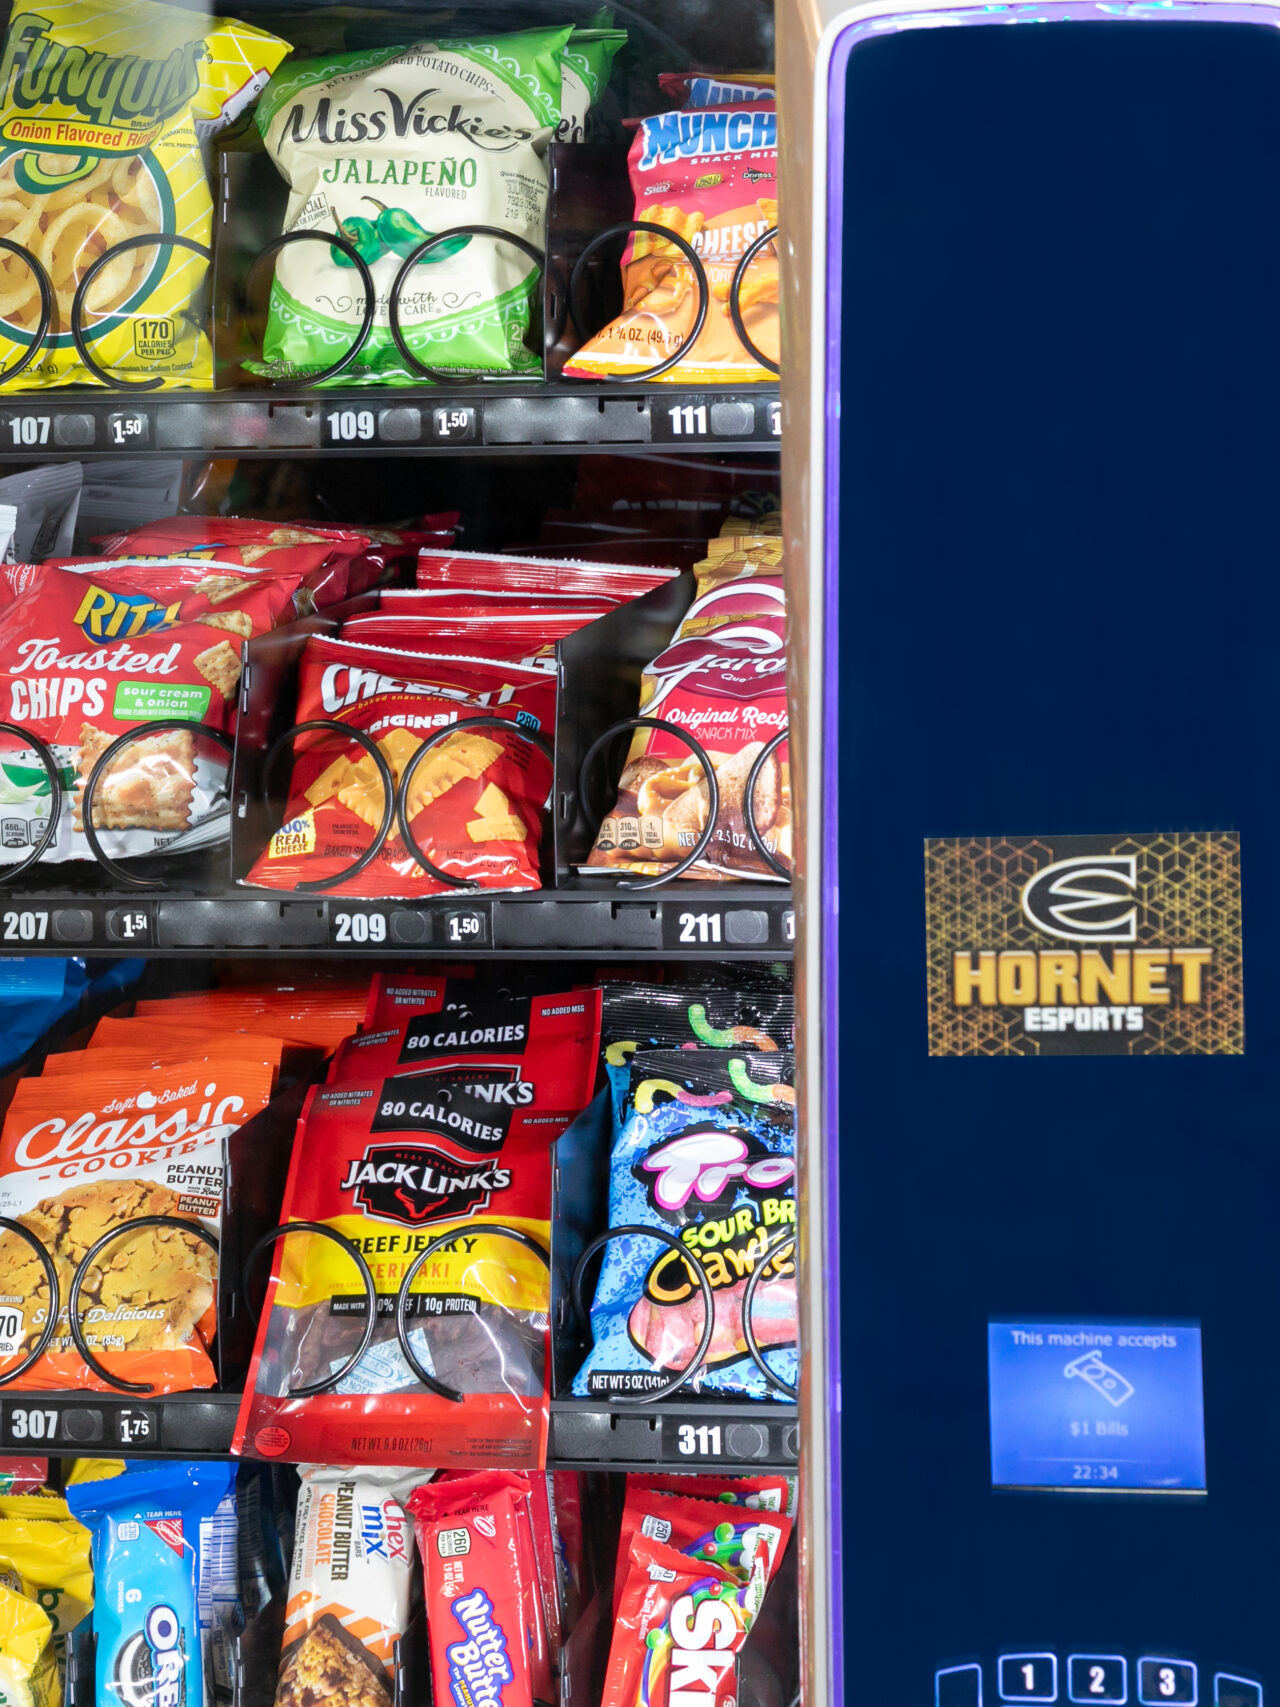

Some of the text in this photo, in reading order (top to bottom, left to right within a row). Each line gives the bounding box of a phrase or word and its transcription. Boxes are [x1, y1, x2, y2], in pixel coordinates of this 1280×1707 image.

[416, 54, 493, 93] POTATO CHIPS
[10, 121, 122, 147] Onion Flavored
[277, 98, 385, 156] Miss
[374, 87, 534, 152] Vickie's
[322, 156, 477, 188] JALAPEÑO
[690, 154, 744, 165] SNACK
[425, 187, 466, 201] FLAVORED
[404, 304, 435, 315] CARE
[140, 321, 169, 339] 170
[138, 340, 172, 350] CALORIES
[9, 416, 50, 445] 107
[113, 419, 142, 444] 1.50
[327, 411, 375, 440] 109
[438, 411, 468, 436] 1.50
[668, 405, 708, 434] 111
[9, 637, 183, 675] Toasted
[9, 677, 109, 721] CHIPS
[123, 686, 203, 699] sour cream
[146, 697, 187, 709] onion
[665, 707, 739, 729] Original
[694, 727, 758, 741] SNACK MIX
[275, 833, 307, 846] REAL
[275, 843, 308, 855] CHEESE
[678, 832, 696, 847] NET
[3, 911, 48, 940] 207
[335, 913, 386, 942] 209
[450, 918, 479, 941] 1.50
[678, 912, 722, 943] 211
[953, 947, 1214, 1006] HORNET
[1024, 1006, 1144, 1031] ESPORTS
[406, 1035, 430, 1049] 80
[433, 1024, 525, 1047] CALORIES
[101, 1080, 198, 1115] Soft Baked
[15, 1083, 246, 1168] Classic
[380, 1101, 503, 1142] 80 CALORIES
[167, 1164, 223, 1177] PEANUT
[167, 1175, 223, 1188] BUTTER
[341, 1159, 511, 1195] JACK LINK'S
[178, 1205, 217, 1217] BUTTER
[179, 1196, 219, 1208] PEANUT
[681, 1210, 755, 1249] SOUR
[350, 1234, 479, 1255] BEEF JERKY
[87, 1305, 165, 1324] Delicious
[425, 1299, 444, 1315] 10g
[1011, 1330, 1177, 1349] This machine accepts
[592, 1374, 625, 1389] NET WT
[11, 1409, 58, 1439] 307
[120, 1420, 149, 1443] 1.75
[1071, 1421, 1128, 1436] $1 Bills
[678, 1425, 722, 1455] 311
[1073, 1465, 1118, 1480] 22:34
[315, 1493, 336, 1566] CHOCOLATE
[331, 1481, 357, 1581] PEANUT BUTTER
[361, 1505, 388, 1558] mix
[382, 1499, 409, 1561] Chex
[453, 1530, 467, 1553] 260
[455, 1592, 510, 1682] Nutter
[1021, 1664, 1035, 1690] 1
[1089, 1666, 1105, 1693] 2
[1159, 1668, 1176, 1696] 3
